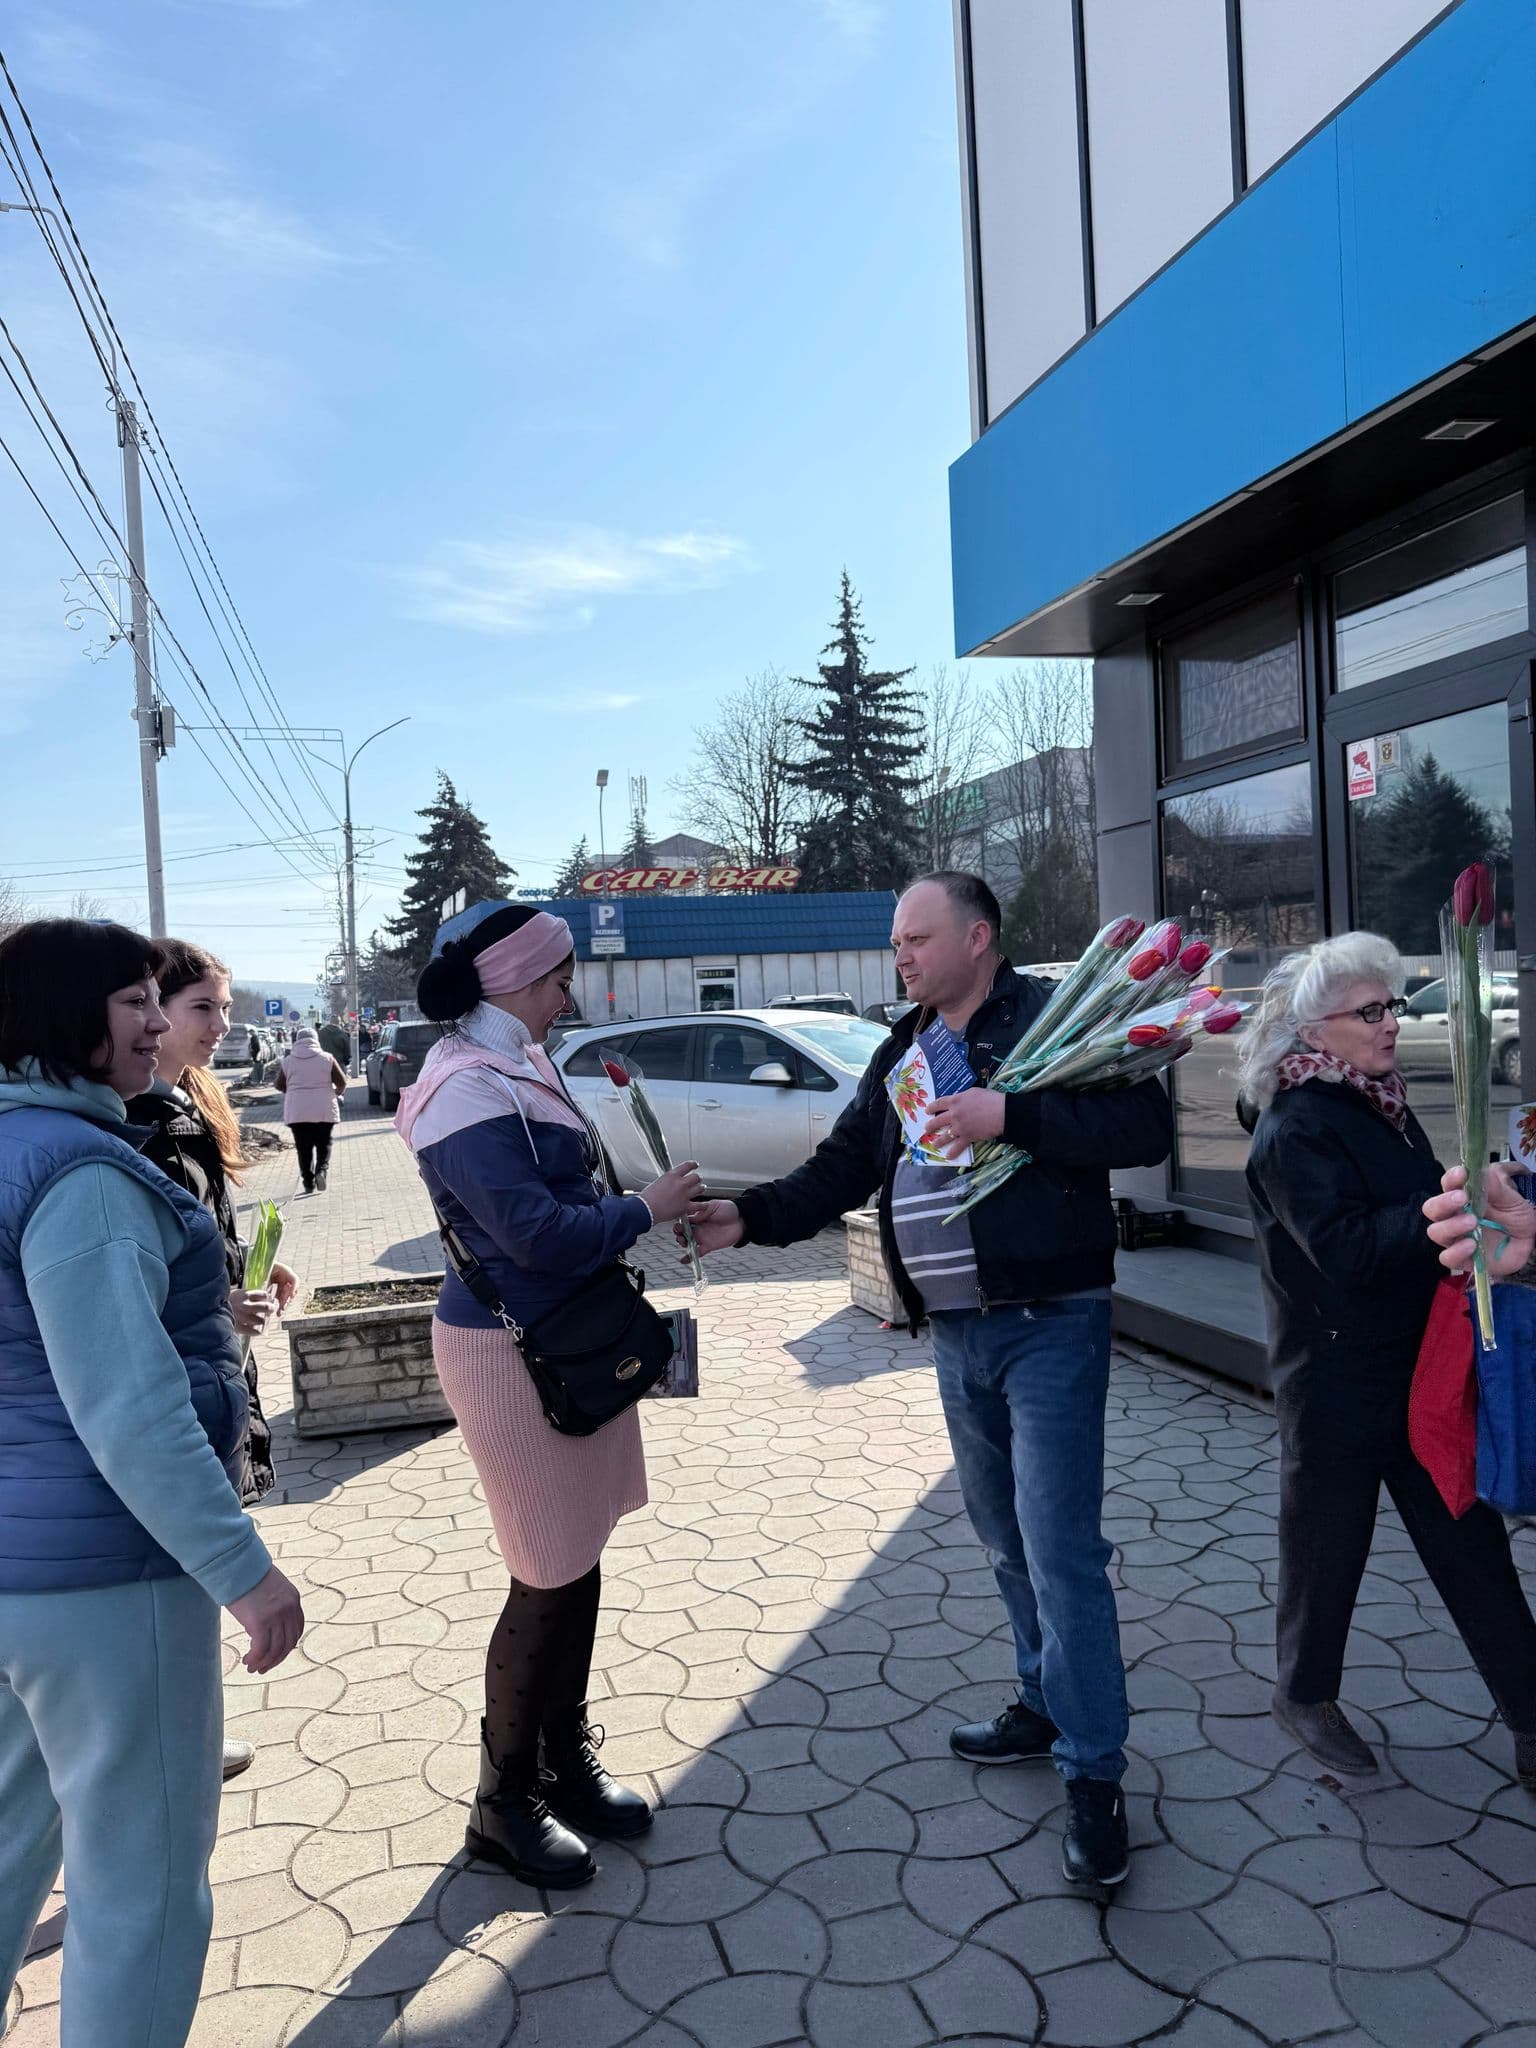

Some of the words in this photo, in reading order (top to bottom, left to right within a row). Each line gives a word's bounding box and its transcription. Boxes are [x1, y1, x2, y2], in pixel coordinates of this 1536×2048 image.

[708, 868, 800, 888] BAR
[598, 905, 615, 926] P
[269, 1000, 279, 1014] P
